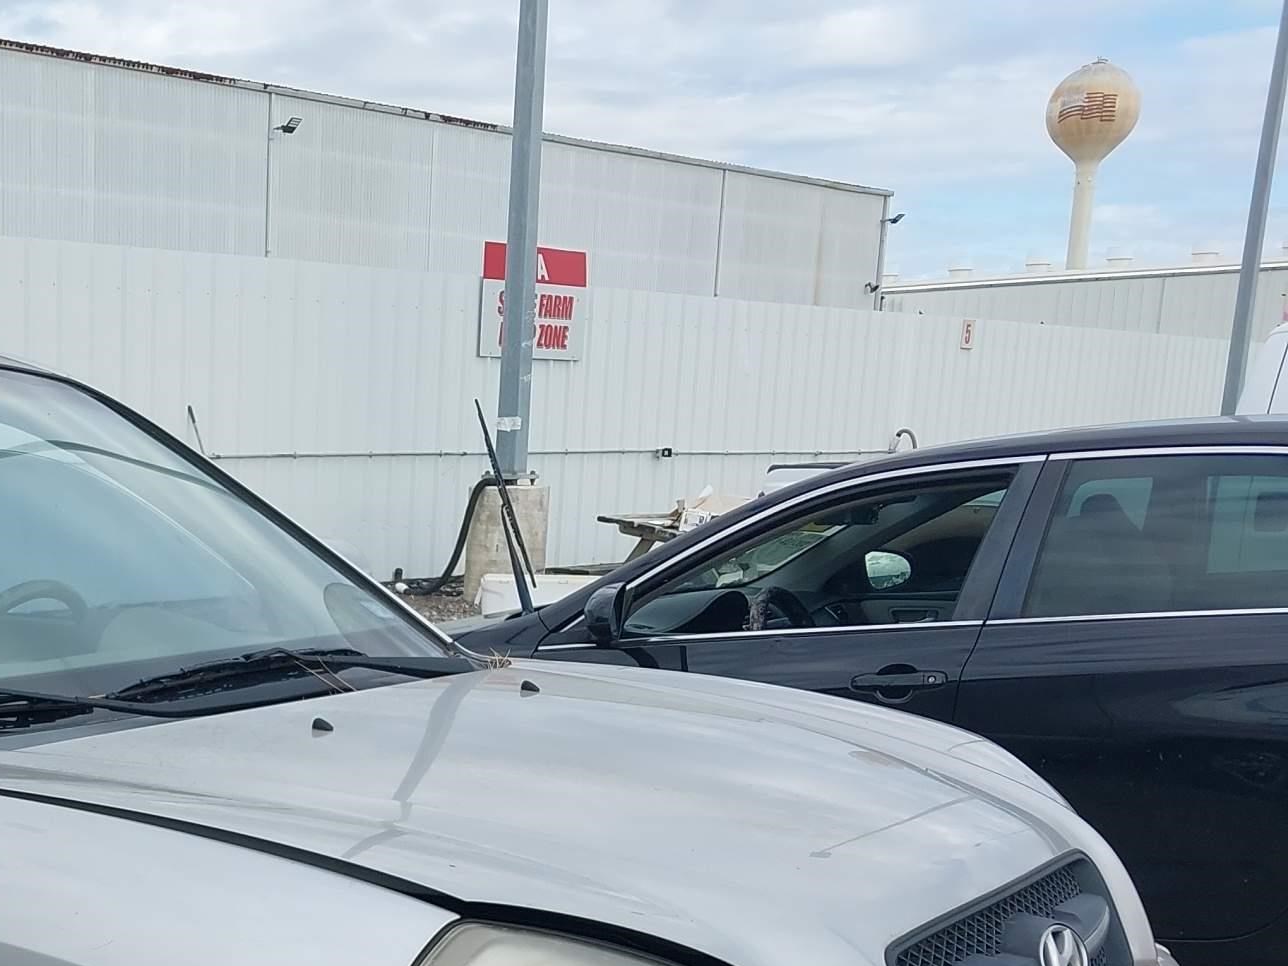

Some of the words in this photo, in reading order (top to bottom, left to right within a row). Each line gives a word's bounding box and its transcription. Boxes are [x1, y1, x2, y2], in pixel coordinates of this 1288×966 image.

[538, 293, 574, 320] FARM
[536, 323, 569, 349] ZONE
[964, 323, 972, 345] 5
